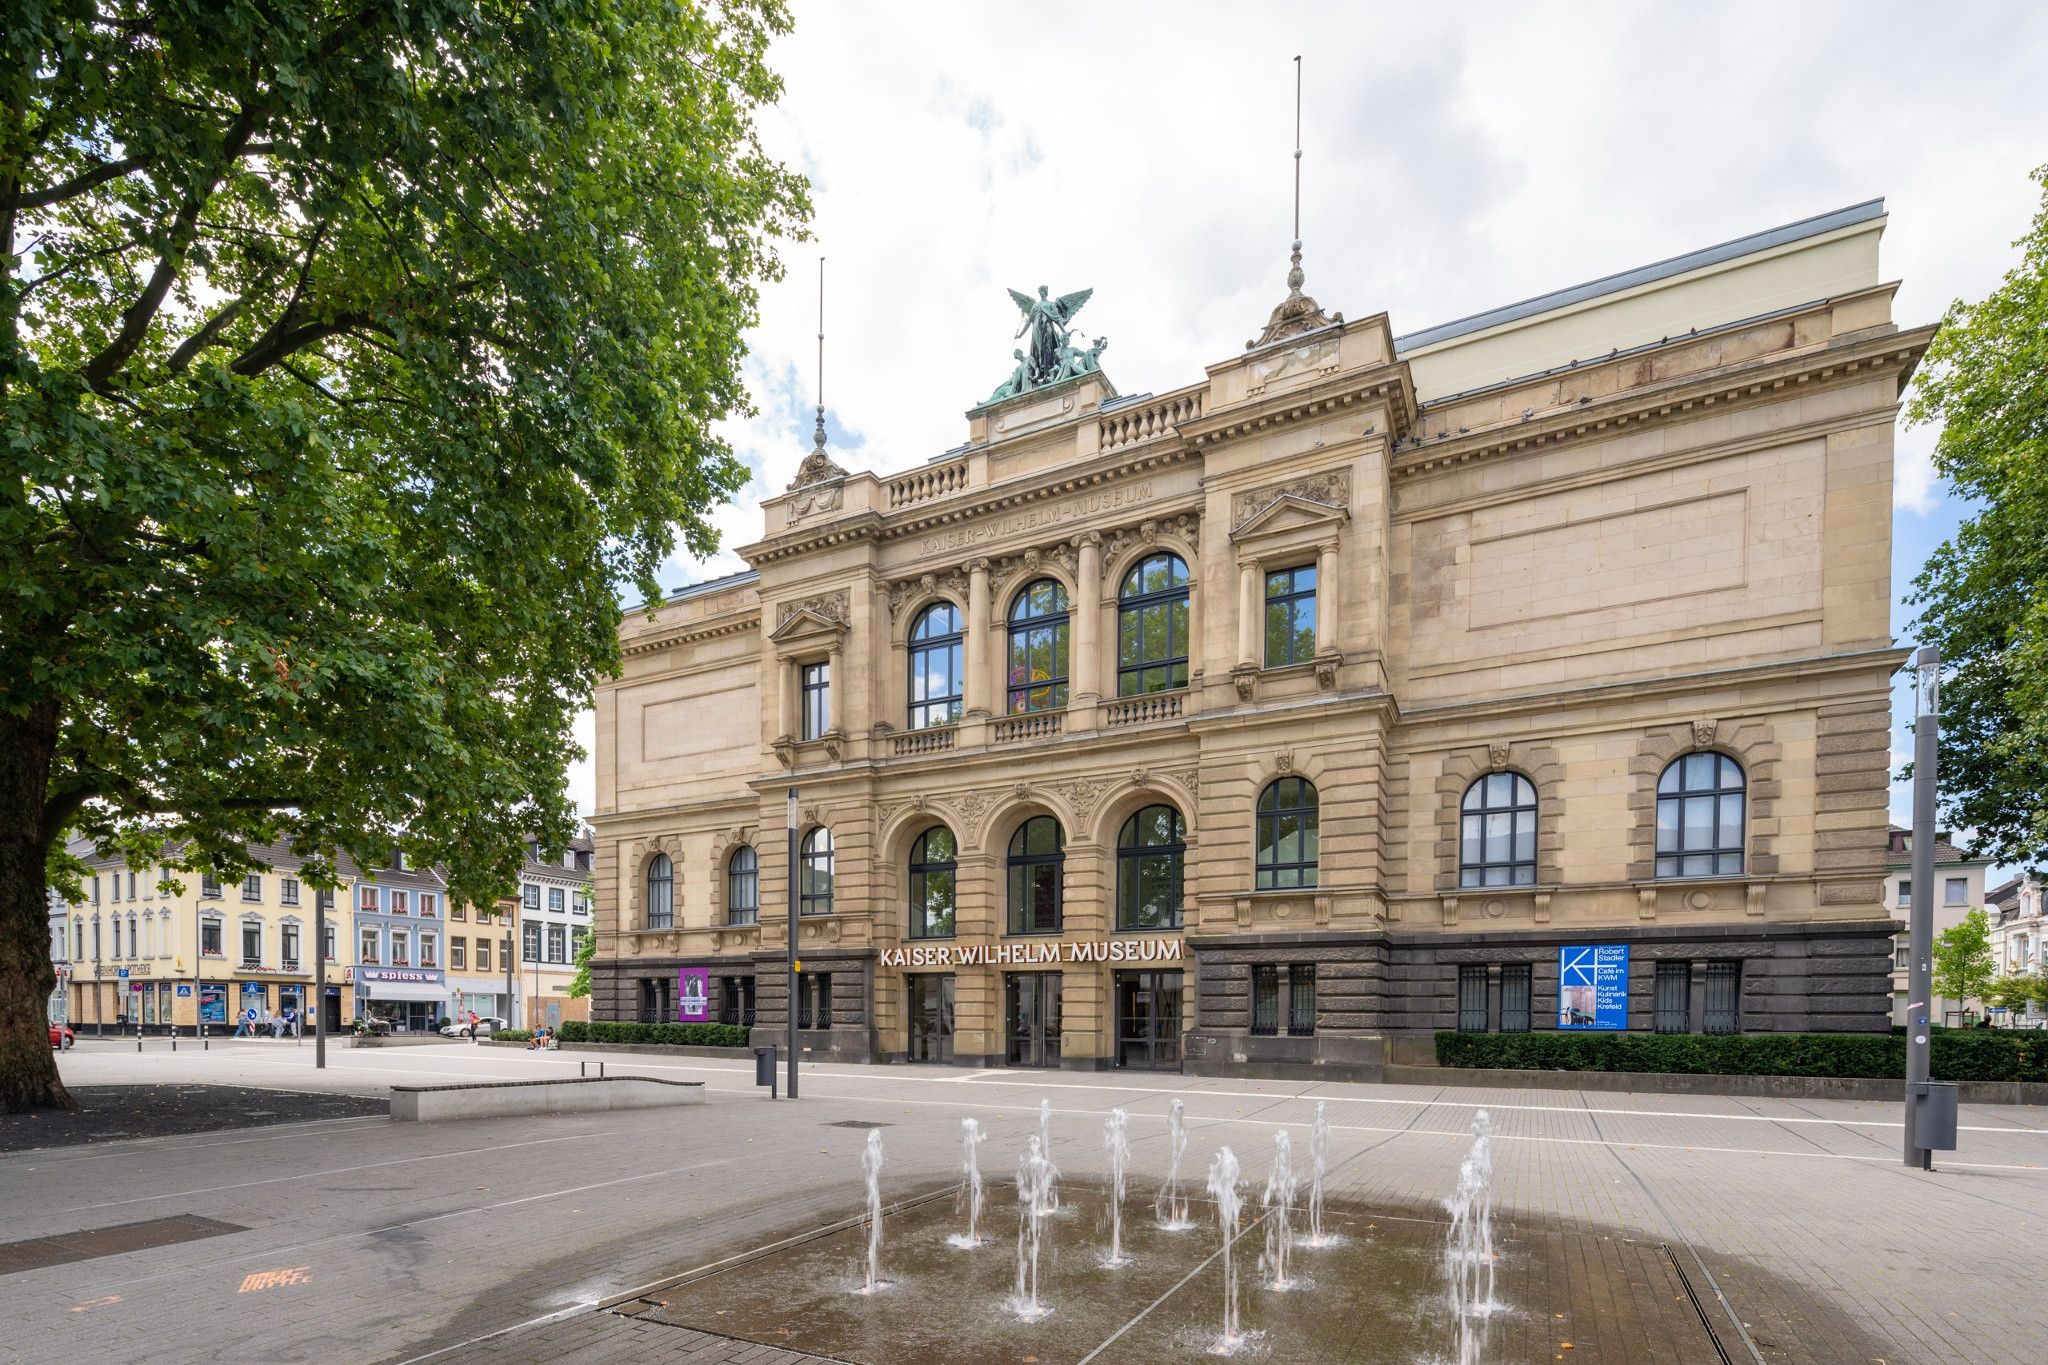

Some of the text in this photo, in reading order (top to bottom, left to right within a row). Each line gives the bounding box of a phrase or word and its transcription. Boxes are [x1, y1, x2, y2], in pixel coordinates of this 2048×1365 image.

[880, 939, 1183, 966] KAISER WILHELM MUSEUM
[381, 971, 423, 981] spiess
